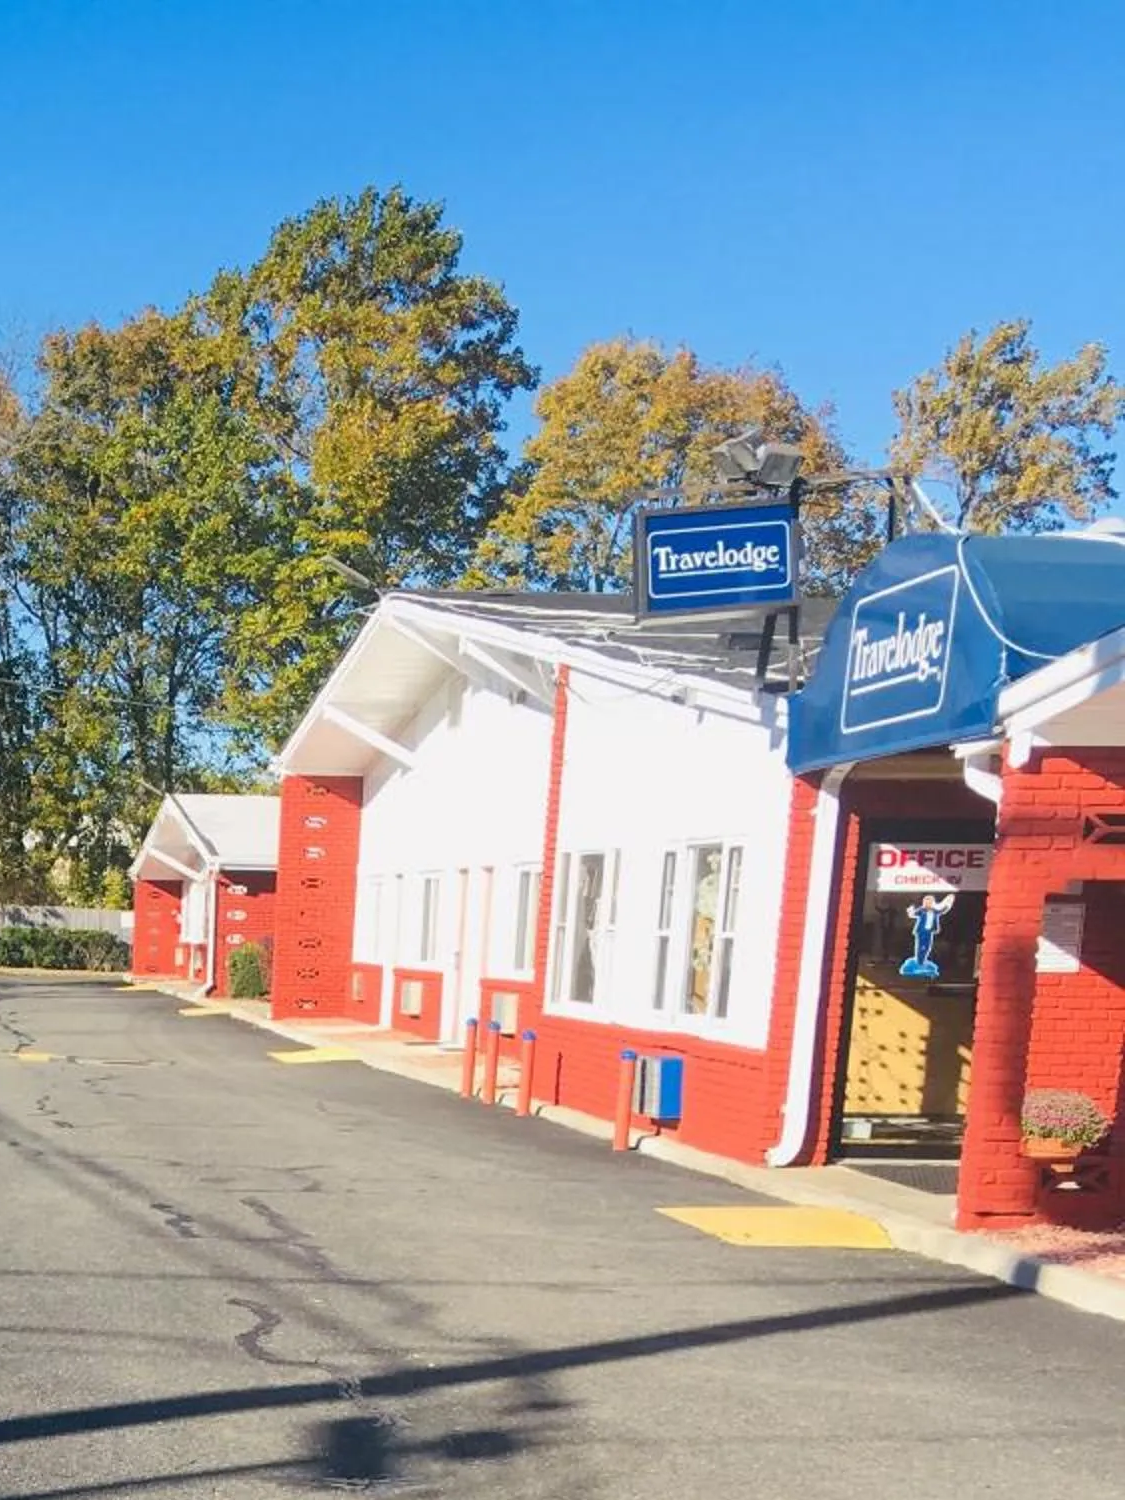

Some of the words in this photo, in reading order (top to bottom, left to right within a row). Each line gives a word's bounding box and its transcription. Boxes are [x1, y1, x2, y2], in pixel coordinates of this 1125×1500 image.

[653, 540, 780, 572] Travelodge
[851, 611, 944, 682] Travelodge
[876, 849, 985, 868] OFFICE
